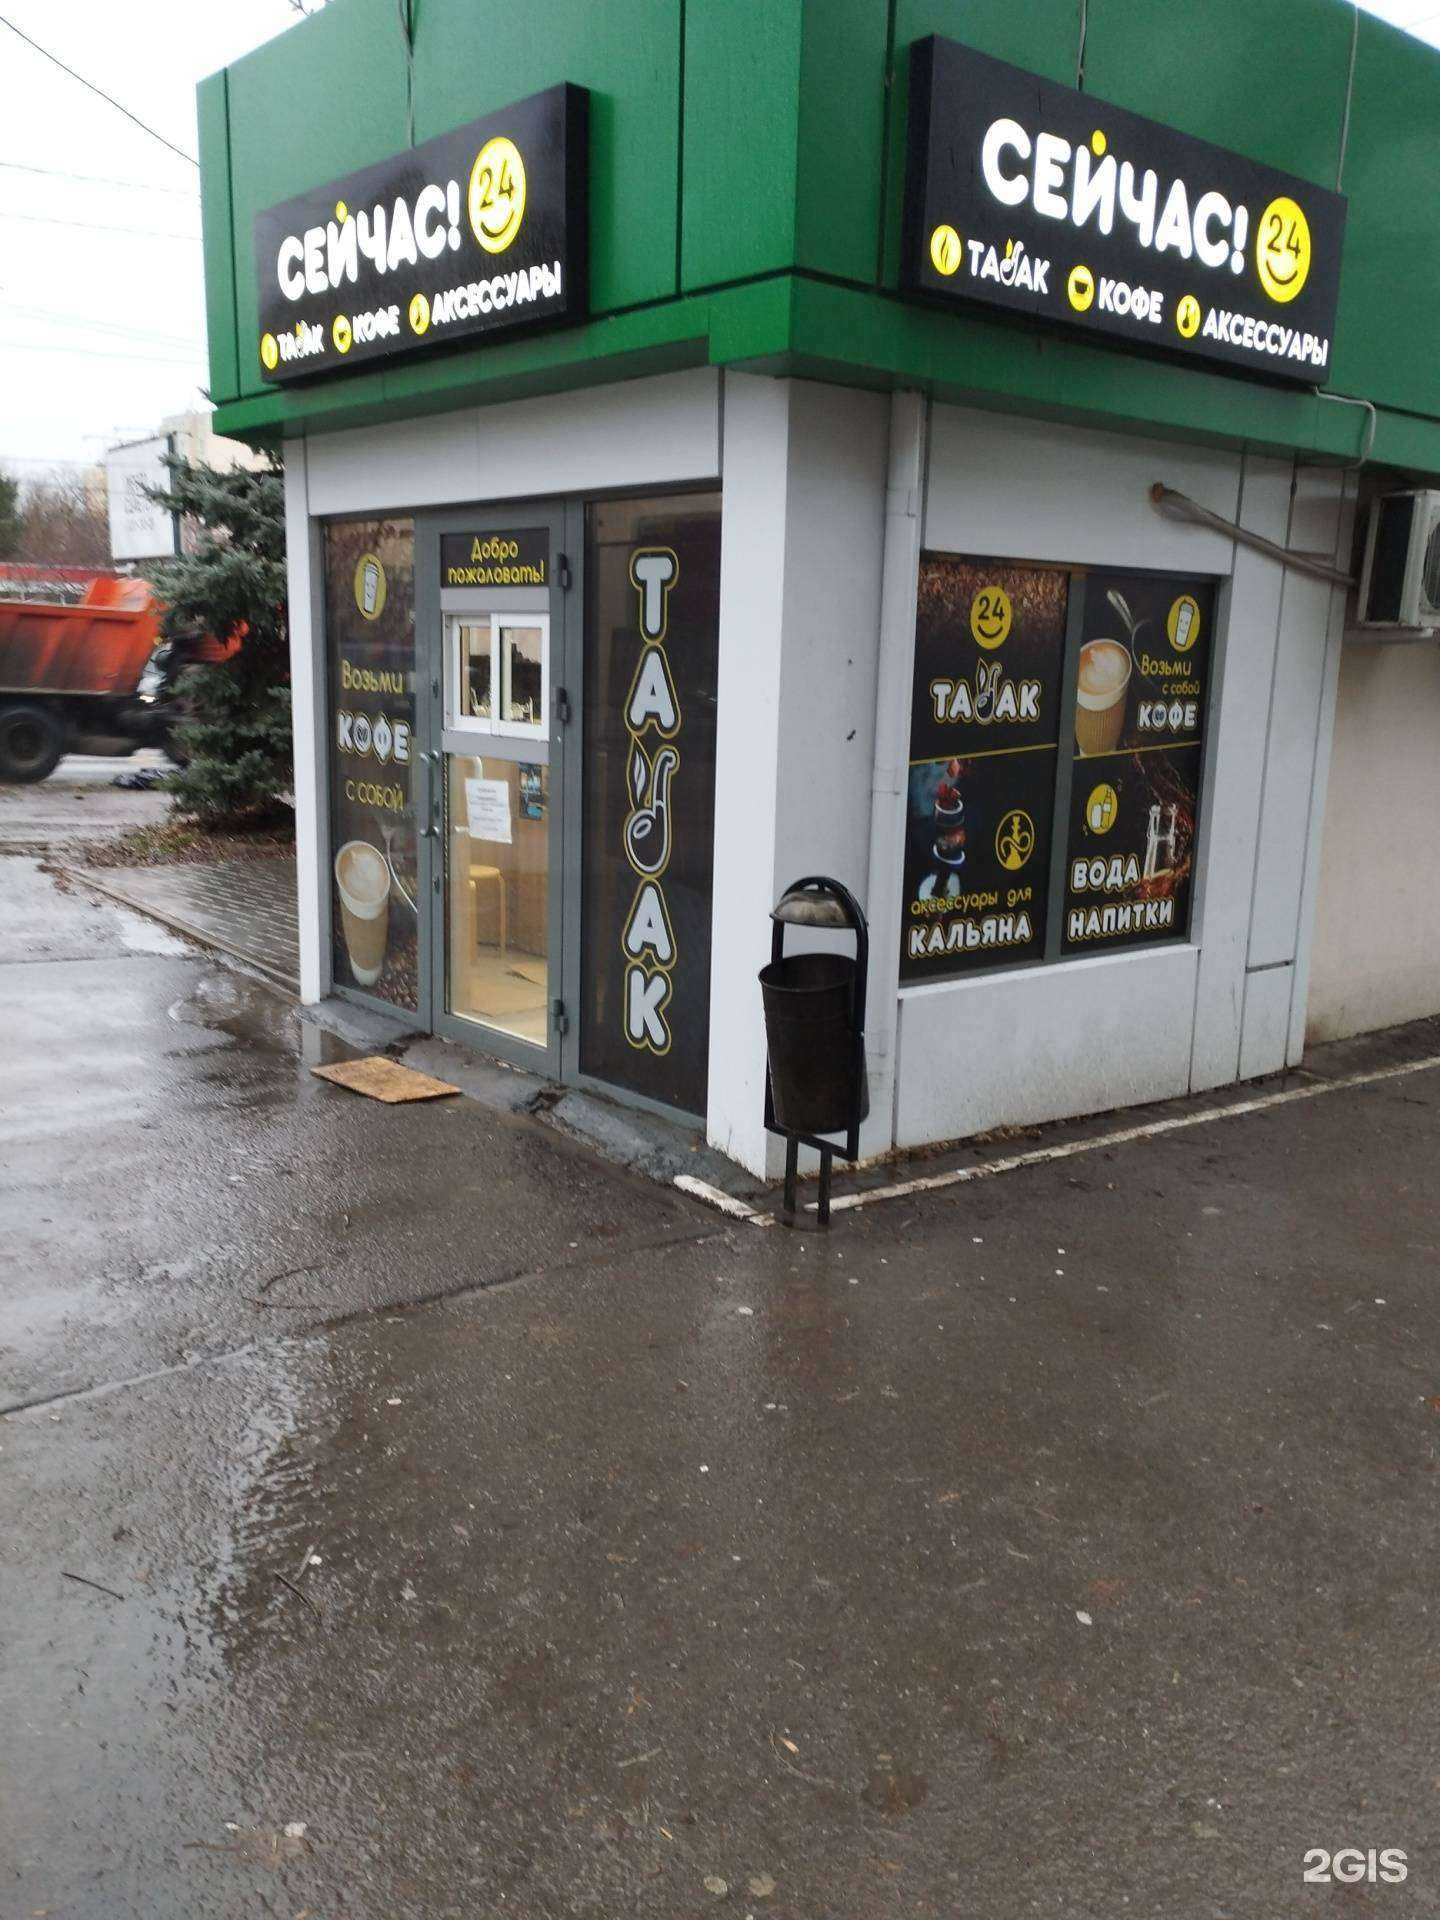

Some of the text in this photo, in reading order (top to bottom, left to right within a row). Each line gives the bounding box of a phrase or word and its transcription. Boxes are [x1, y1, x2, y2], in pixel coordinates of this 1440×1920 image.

[982, 118, 1302, 275] СЕЙЧАС! 24
[277, 180, 461, 301] СЕЙЧАС!
[352, 305, 401, 344] КОФЕ
[432, 260, 562, 325] АКСЕССУАРЫ
[1098, 277, 1164, 324] КОФЕ
[1202, 308, 1329, 366] АКСЕССУАРЫ
[470, 536, 519, 565] Добро
[447, 559, 544, 584] пожаловать!
[978, 596, 1006, 621] 24
[341, 659, 404, 694] Возьми
[1140, 654, 1192, 676] Возьми
[1138, 701, 1197, 731] КОФЕ
[337, 711, 411, 762] КОФЕ
[1070, 854, 1140, 893] ВОДА
[911, 886, 1032, 915] аксессуары для
[1068, 897, 1174, 941] НАПИТКИ
[908, 911, 1032, 957] КАЛЬЯНА
